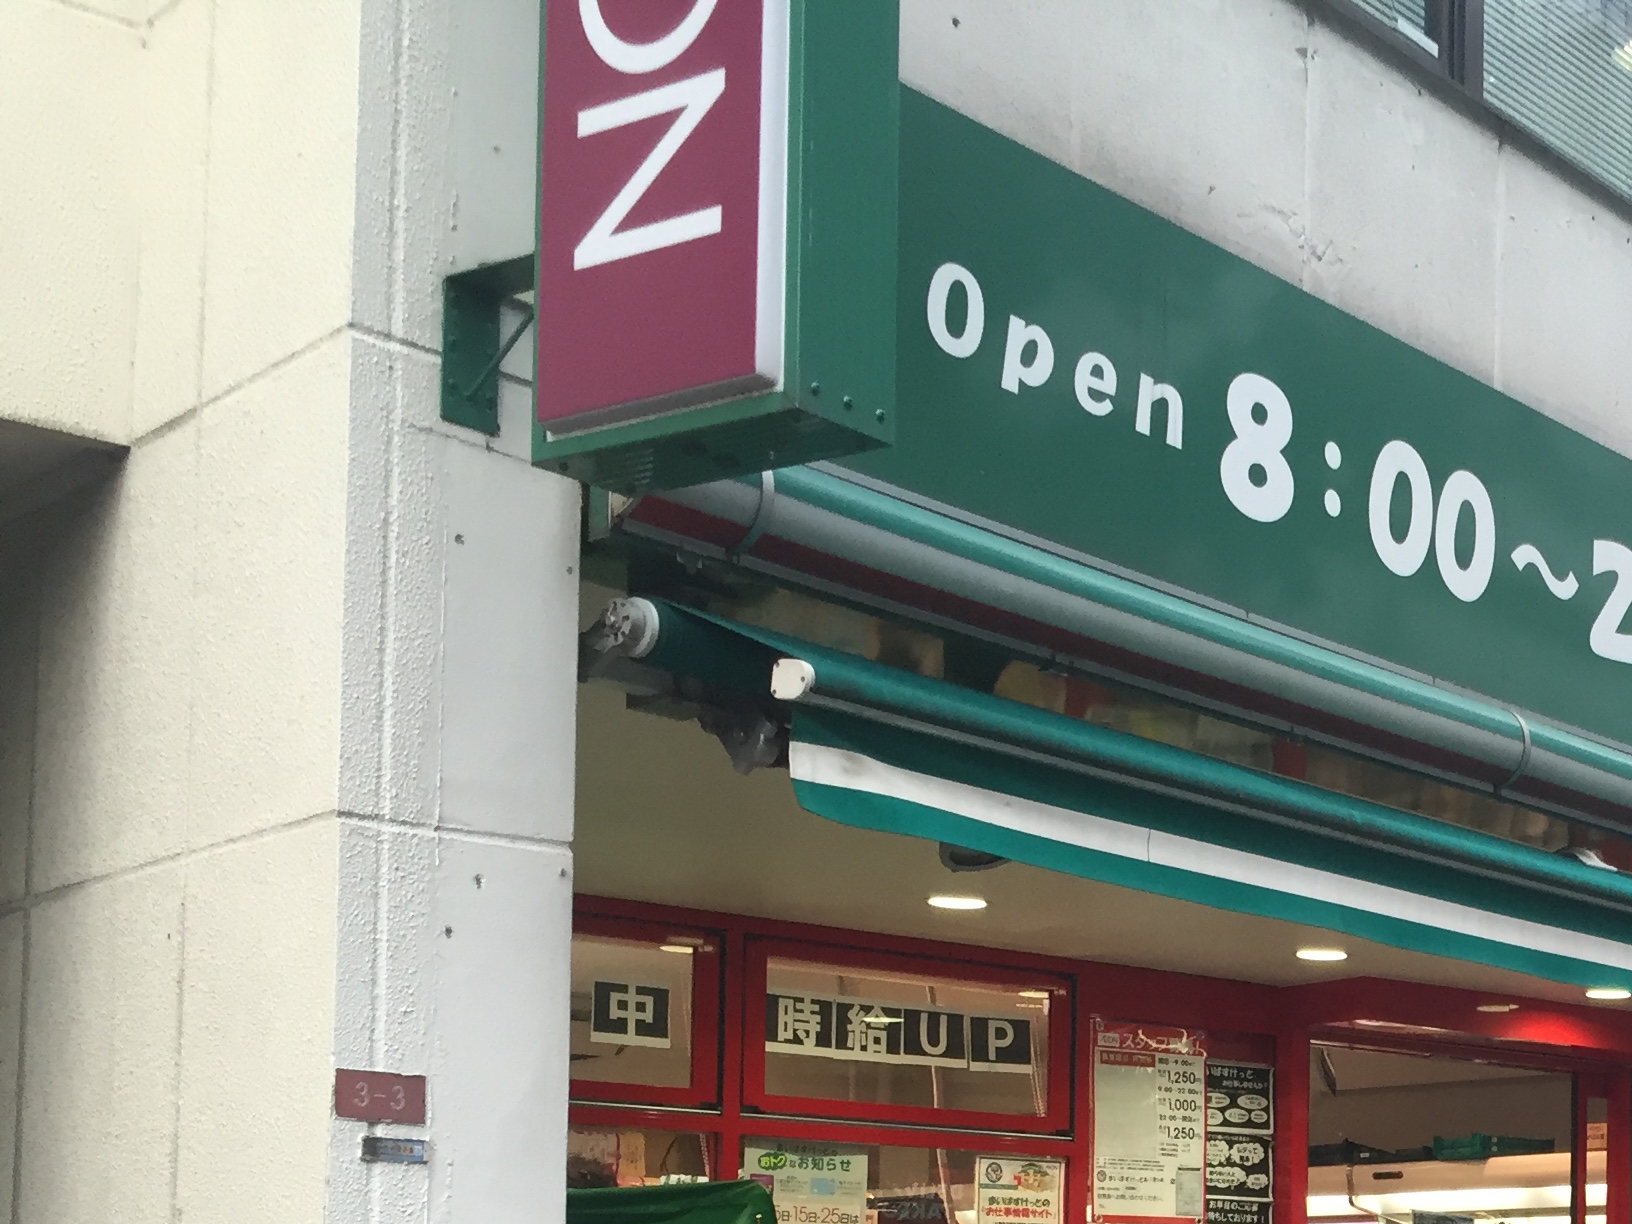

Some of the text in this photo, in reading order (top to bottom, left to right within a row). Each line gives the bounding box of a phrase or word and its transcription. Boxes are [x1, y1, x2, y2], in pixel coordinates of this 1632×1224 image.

[927, 262, 1183, 449] Open
[609, 983, 655, 1036] 中
[353, 1081, 405, 1111] 3-3
